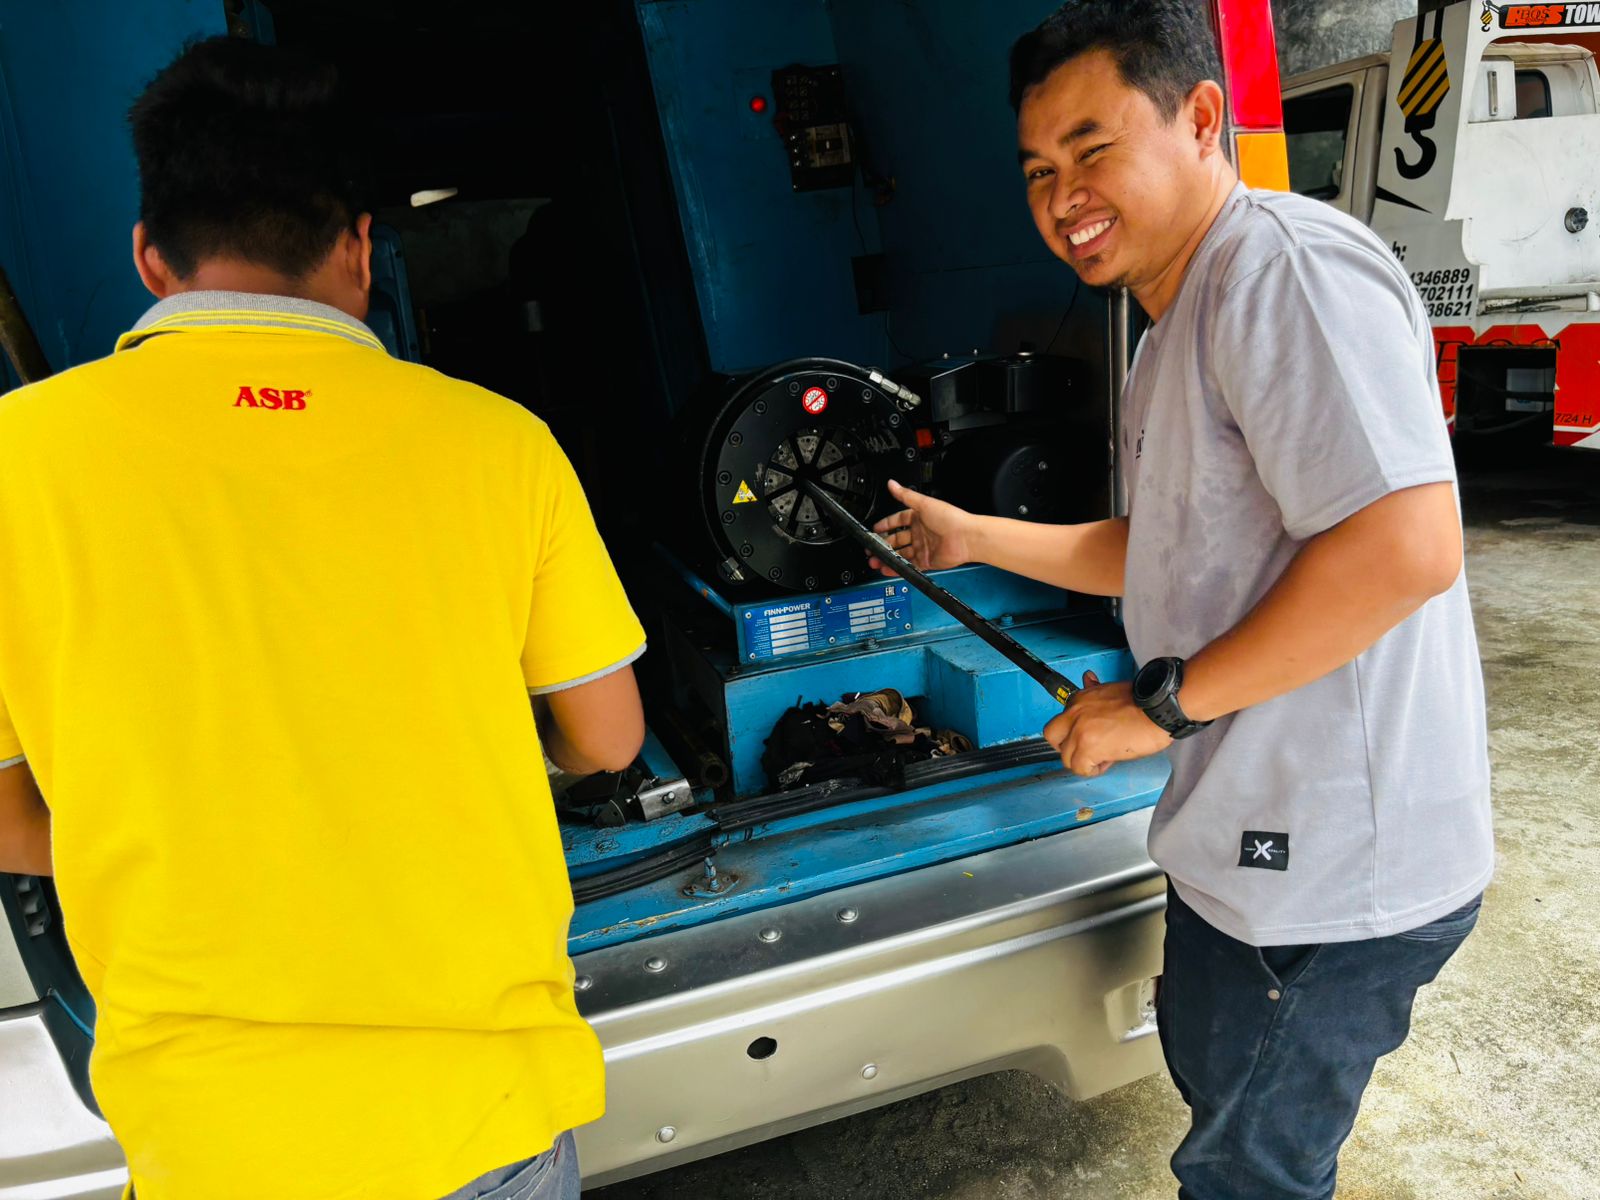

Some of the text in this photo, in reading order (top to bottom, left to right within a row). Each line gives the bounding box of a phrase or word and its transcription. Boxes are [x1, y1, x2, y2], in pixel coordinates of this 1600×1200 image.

[1505, 5, 1565, 27] BOS
[1416, 284, 1474, 301] 702111
[1423, 301, 1472, 317] 38621
[232, 386, 306, 411] ASB
